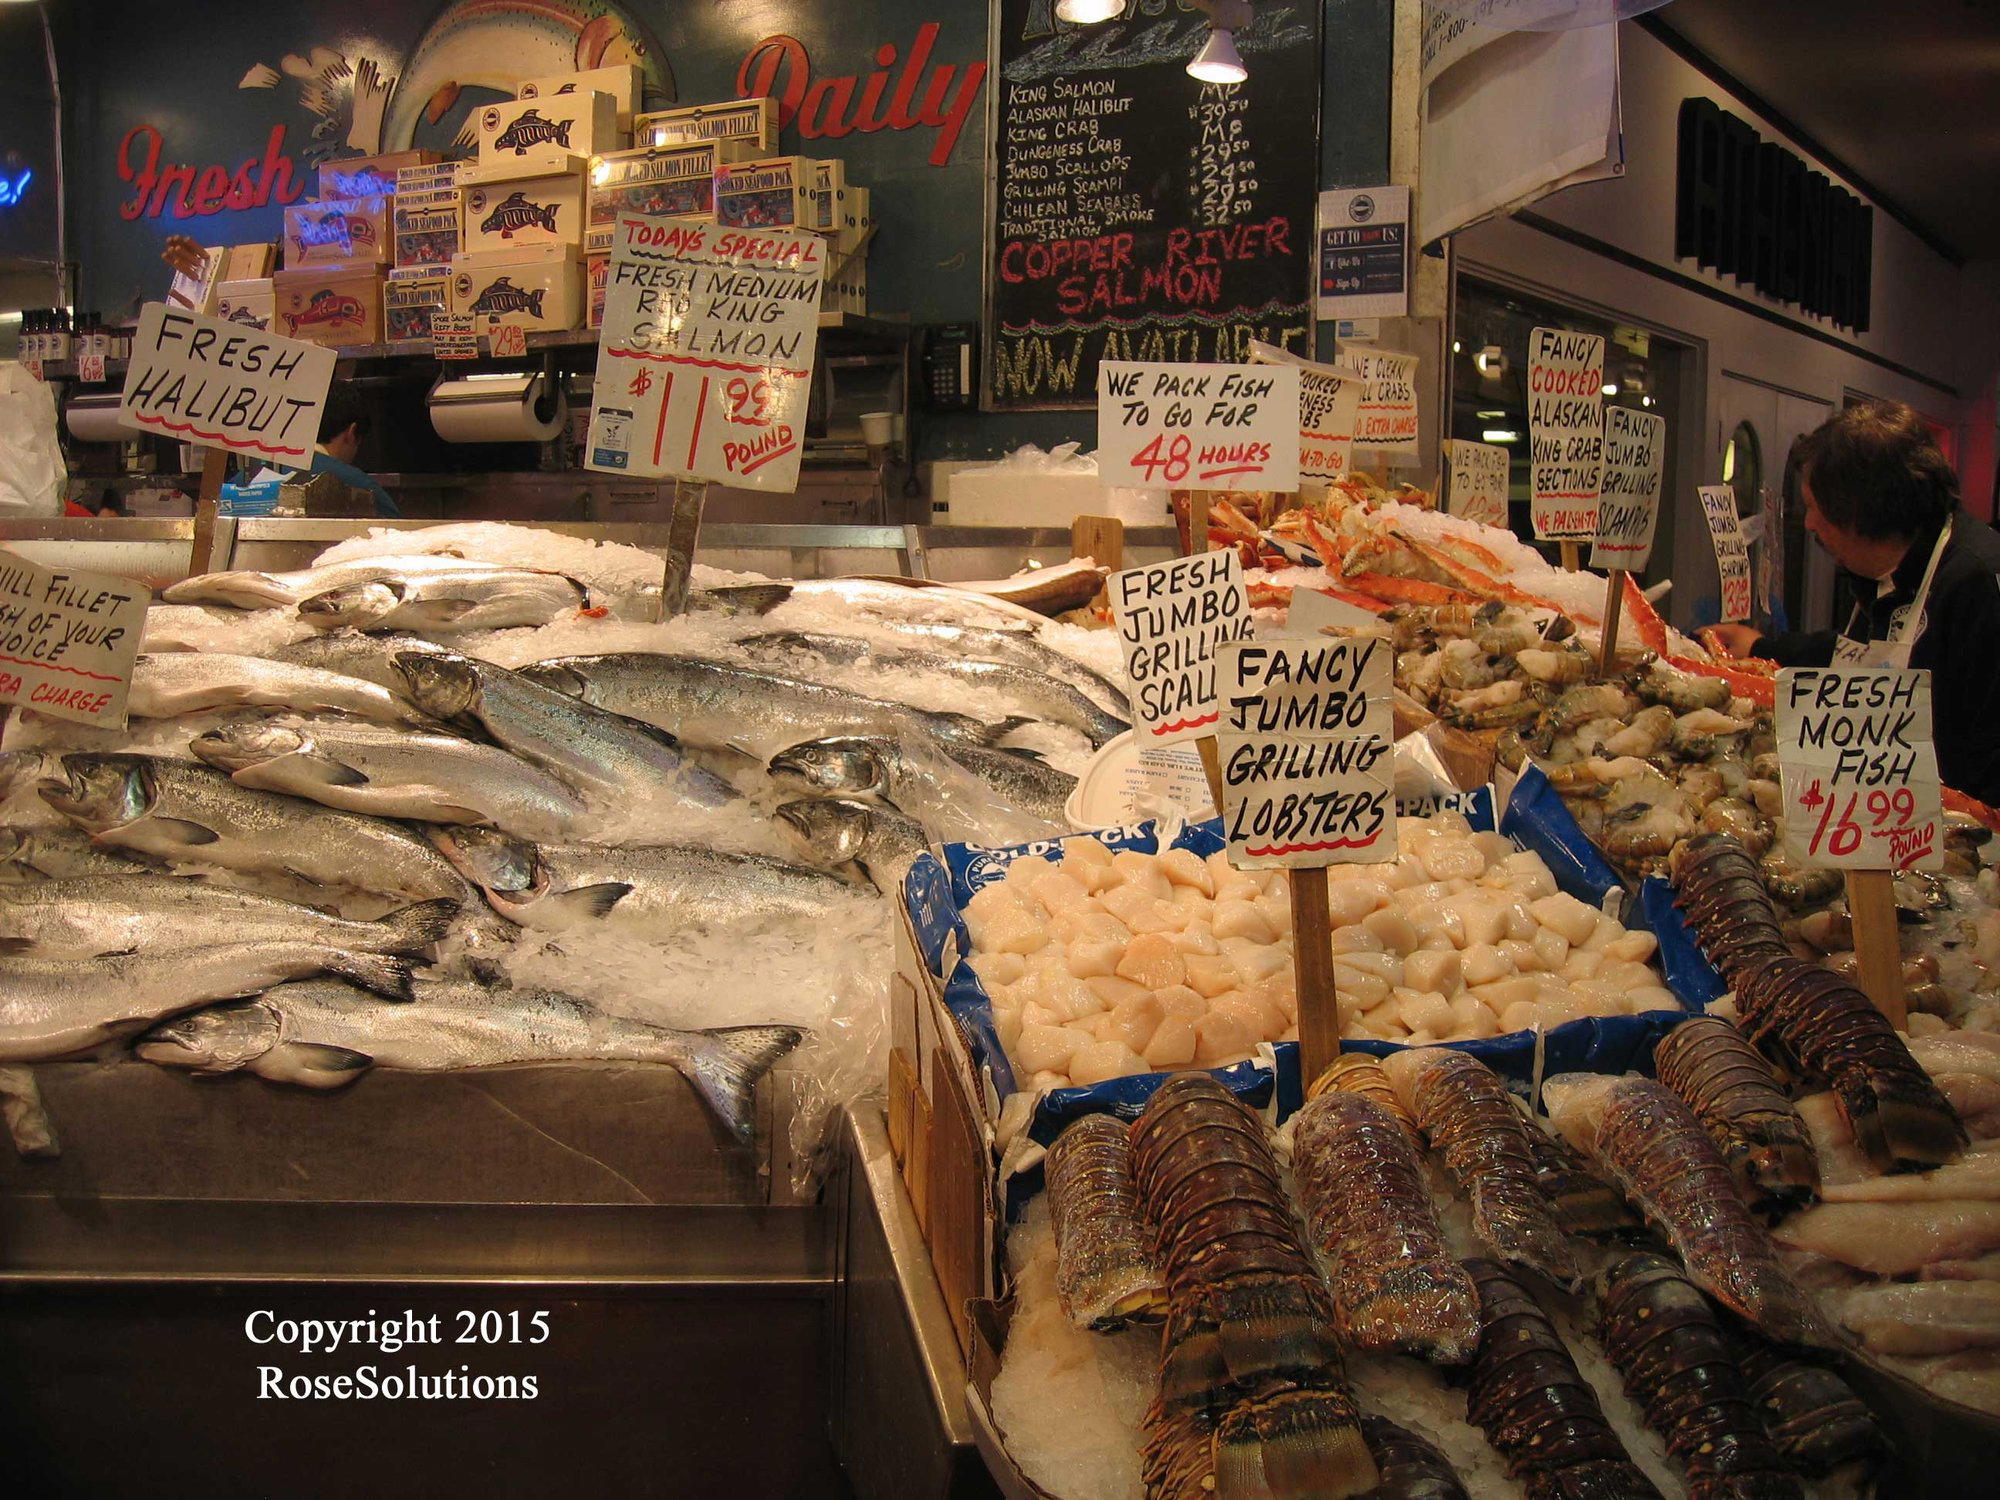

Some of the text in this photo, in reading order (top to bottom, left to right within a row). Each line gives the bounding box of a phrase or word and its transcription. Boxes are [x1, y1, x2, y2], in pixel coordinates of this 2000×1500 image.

[736, 22, 988, 167] Daily
[1008, 77, 1116, 105] KING SALMON
[729, 113, 760, 133] FILLET
[1007, 104, 1068, 124] ALASKAN
[1007, 119, 1099, 143] KING CRAB
[650, 159, 681, 180] SALMON
[682, 152, 714, 176] FILLET
[1008, 135, 1122, 162] DUNGENESS CRAB
[118, 124, 305, 221] Fresh
[1005, 156, 1132, 179] JUMBO SCALLOPS
[1003, 177, 1122, 199] GRILLING SCAMPI
[1003, 199, 1068, 219] CHILEAN
[622, 219, 818, 263] TODAY'S SPECIAL
[1001, 215, 1292, 283] COPPER RIVER
[1327, 231, 1346, 246] GET
[1347, 229, 1360, 244] TO
[615, 260, 820, 304] FRESH MEDIUM
[1056, 261, 1223, 315] SALMON
[706, 296, 786, 324] KING
[155, 313, 305, 380] FRESH
[1539, 332, 1599, 369] FANCY
[995, 335, 1085, 399] NOW
[1107, 369, 1275, 399] WE PACK FISH
[1376, 357, 1409, 380] CLEAN
[127, 365, 316, 439] HALIBUT
[1377, 382, 1411, 402] CRABS
[1121, 400, 1259, 428] TO GO FOR
[1532, 398, 1601, 429] ALASKAN
[1613, 410, 1658, 446] FANCY
[722, 425, 794, 473] POUND
[1129, 433, 1273, 483] 48 HOURS
[1531, 436, 1602, 465] KING CRAB
[1605, 441, 1651, 468] JUMBO
[1536, 467, 1599, 491] SECTIONS
[1600, 470, 1659, 496] GRILLING
[44, 575, 132, 617] FILLET
[1121, 552, 1231, 607] FRESH
[27, 612, 62, 636] OF
[64, 619, 126, 651] YOUR
[1123, 584, 1241, 644] JUMBO
[1236, 639, 1377, 691] FANCY
[31, 682, 113, 714] CHARGE
[1790, 671, 1920, 709] FRESH
[1229, 691, 1367, 732] JUMBO
[1798, 710, 1916, 749] MONK
[1226, 734, 1390, 786] GRILLING
[1830, 748, 1917, 787] FISH
[1228, 789, 1389, 843] LOBSTERS
[1888, 821, 1934, 863] POUND
